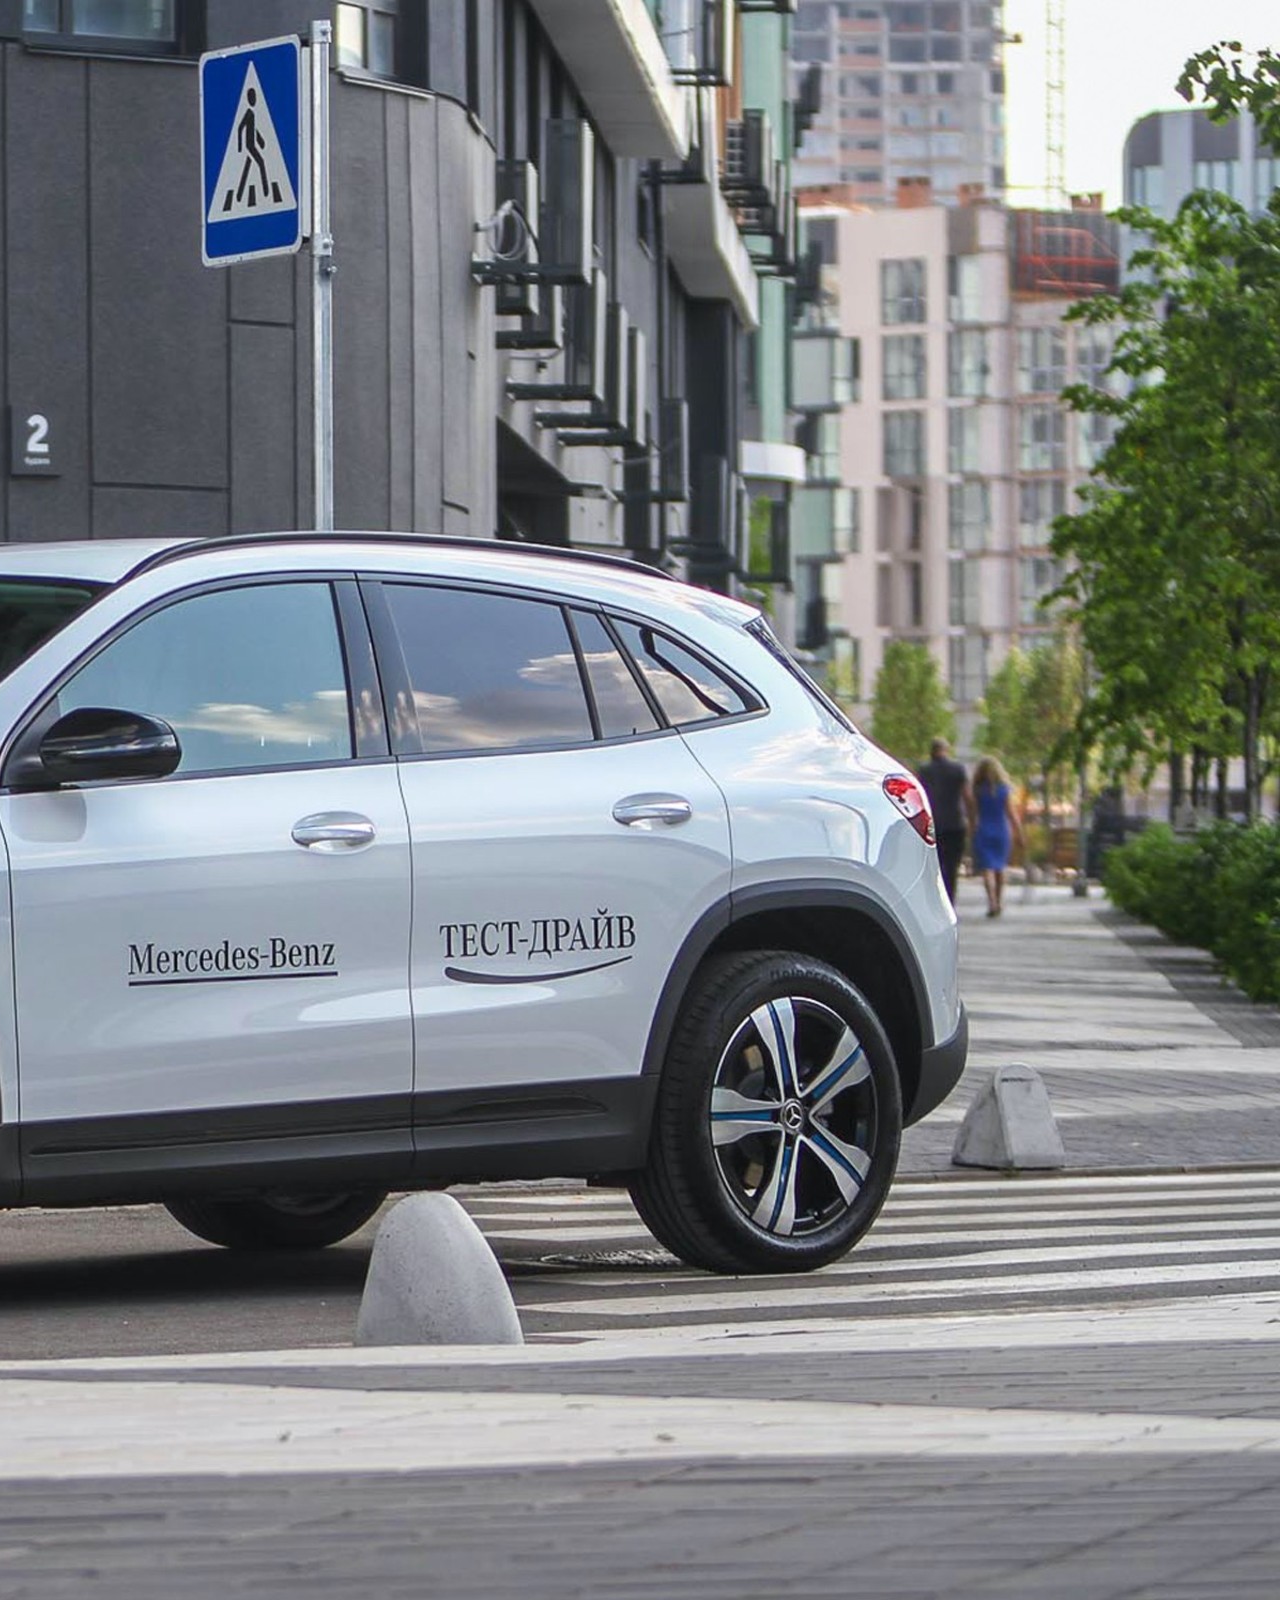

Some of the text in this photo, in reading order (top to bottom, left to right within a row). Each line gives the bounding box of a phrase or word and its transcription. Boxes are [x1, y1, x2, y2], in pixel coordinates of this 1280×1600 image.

[27, 413, 50, 453] 2
[438, 908, 637, 960] ТЕСТ-ДРАЙВ
[127, 938, 336, 976] Mercedes-Benz
